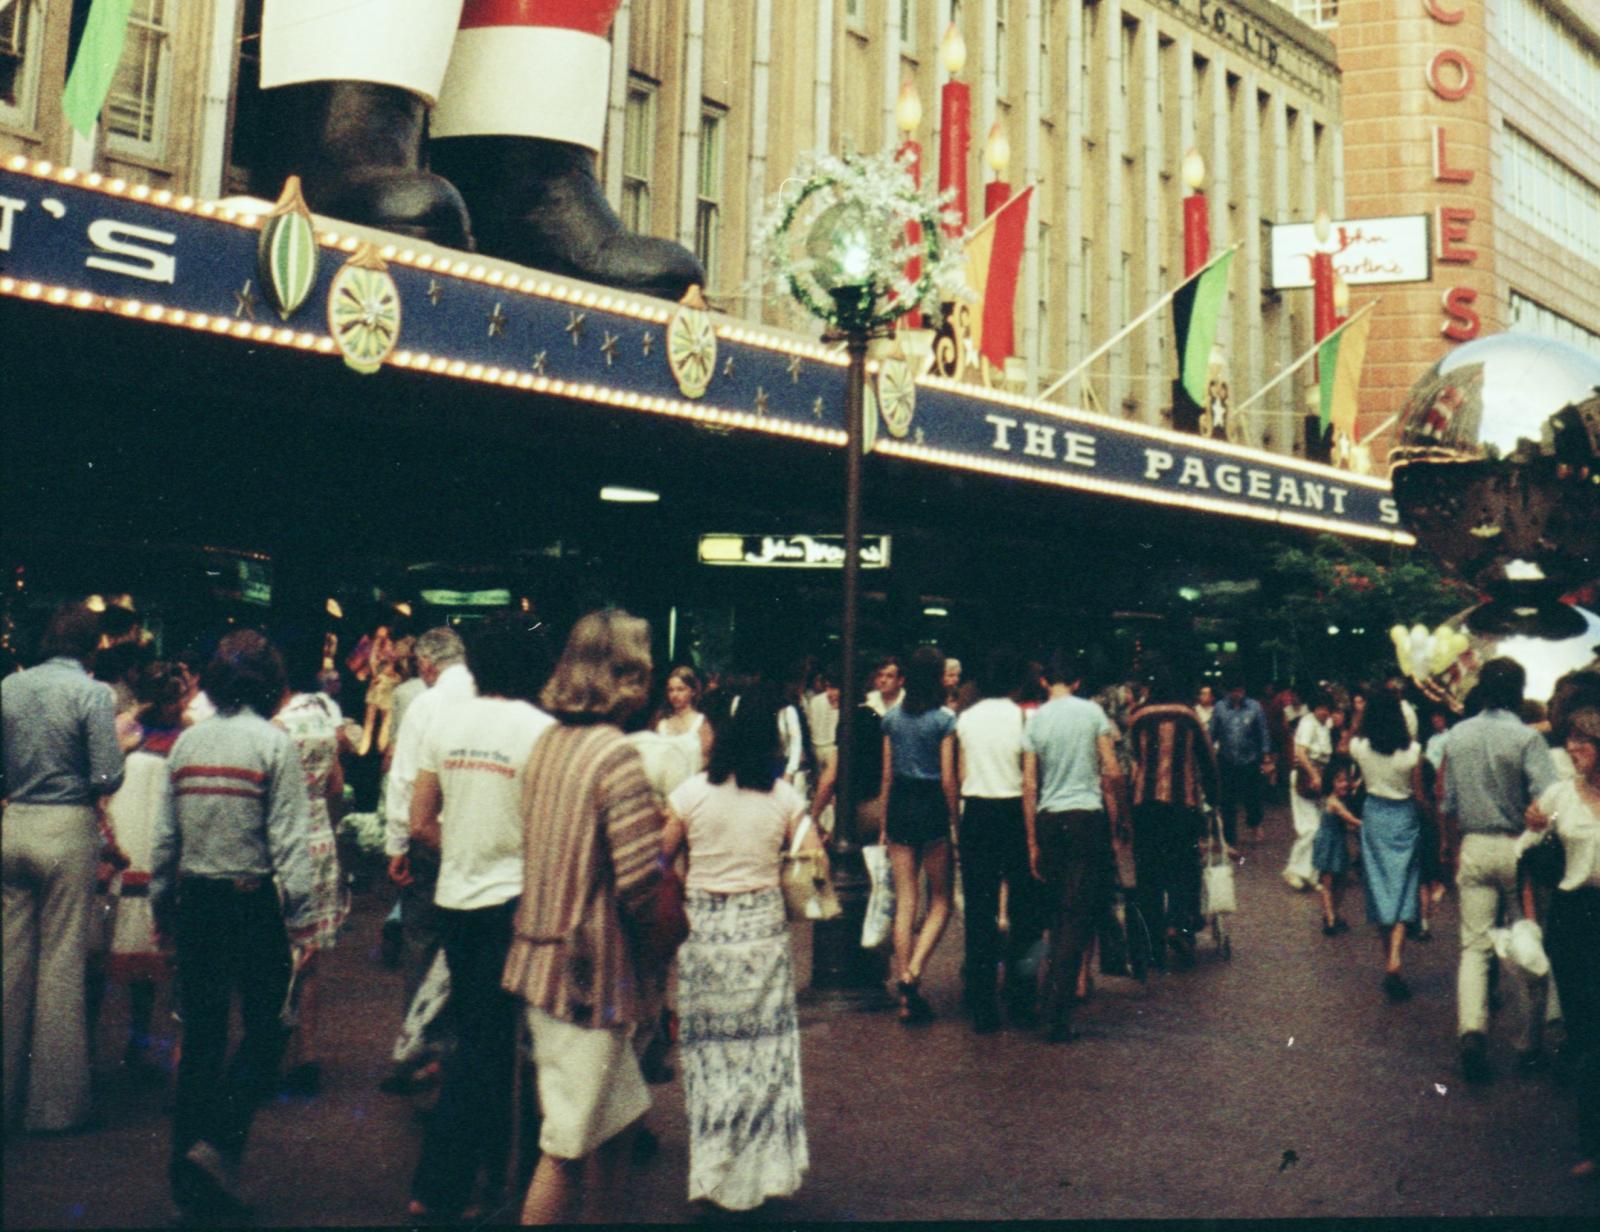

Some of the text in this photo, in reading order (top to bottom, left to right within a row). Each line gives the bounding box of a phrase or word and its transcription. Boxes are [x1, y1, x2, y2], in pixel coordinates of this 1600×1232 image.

[1331, 226, 1388, 255] John
[985, 415, 1097, 467] THE
[1143, 449, 1349, 515] PAGEANT
